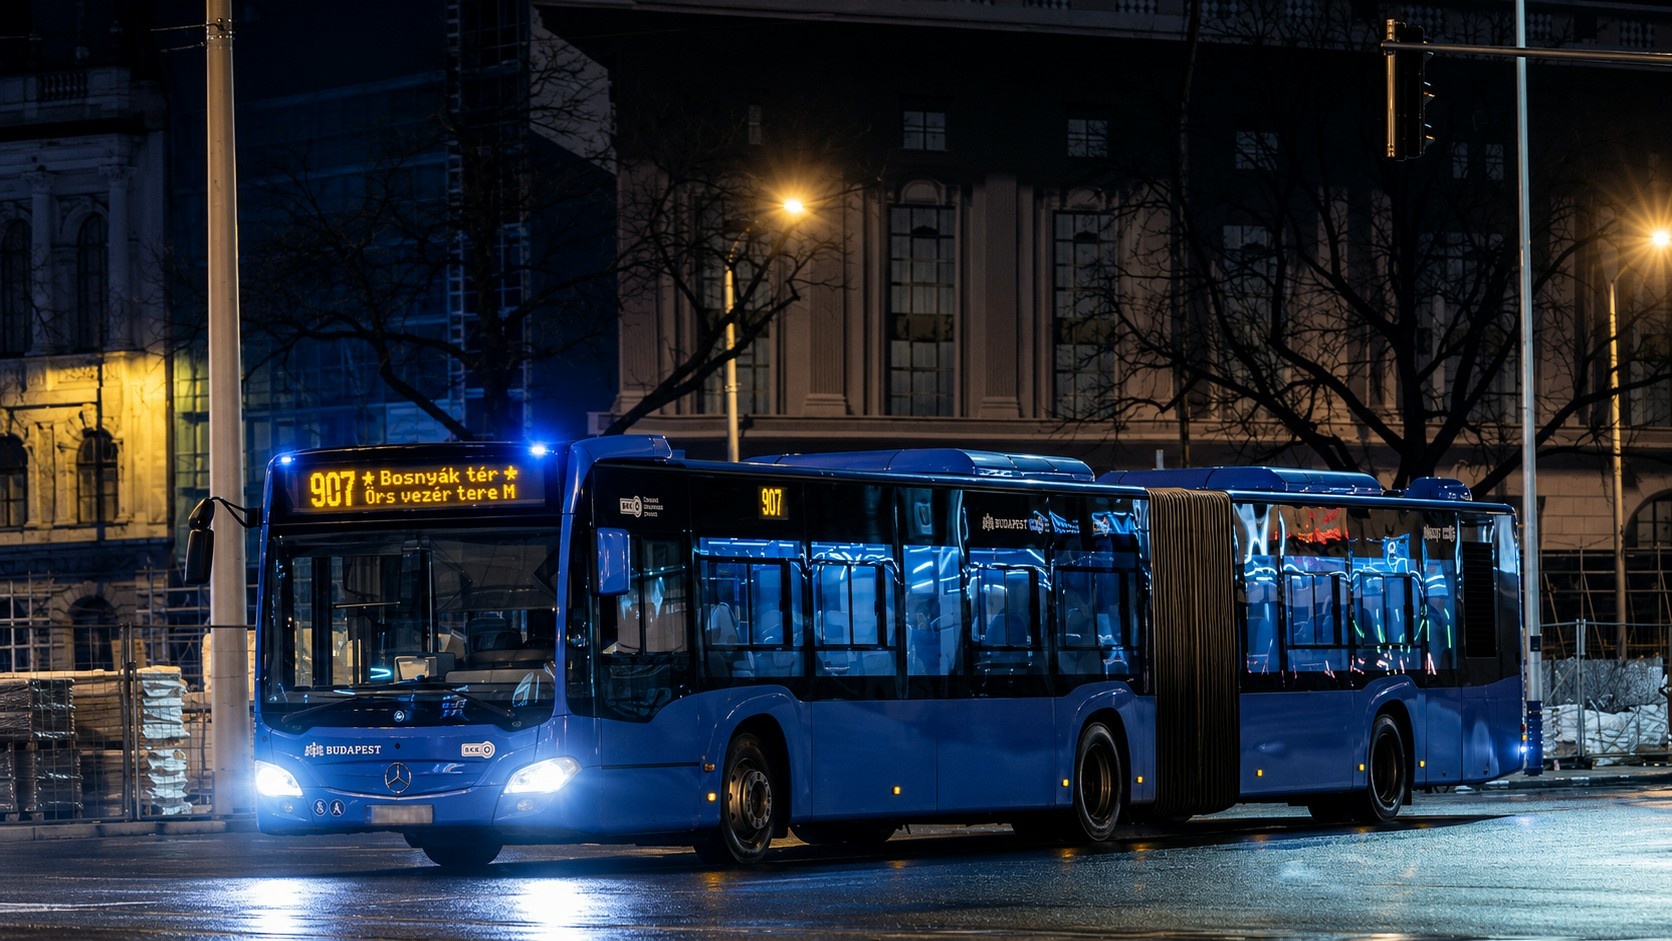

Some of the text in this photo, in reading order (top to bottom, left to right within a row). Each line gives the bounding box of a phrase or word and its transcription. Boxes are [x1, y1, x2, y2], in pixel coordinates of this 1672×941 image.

[380, 466, 499, 486] Bosnyák tér
[310, 470, 356, 508] 907
[365, 484, 516, 504] Örs vezér tere M
[761, 488, 782, 516] 907
[994, 518, 1028, 530] BUDAPEST
[326, 744, 382, 755] BUDAPEST
